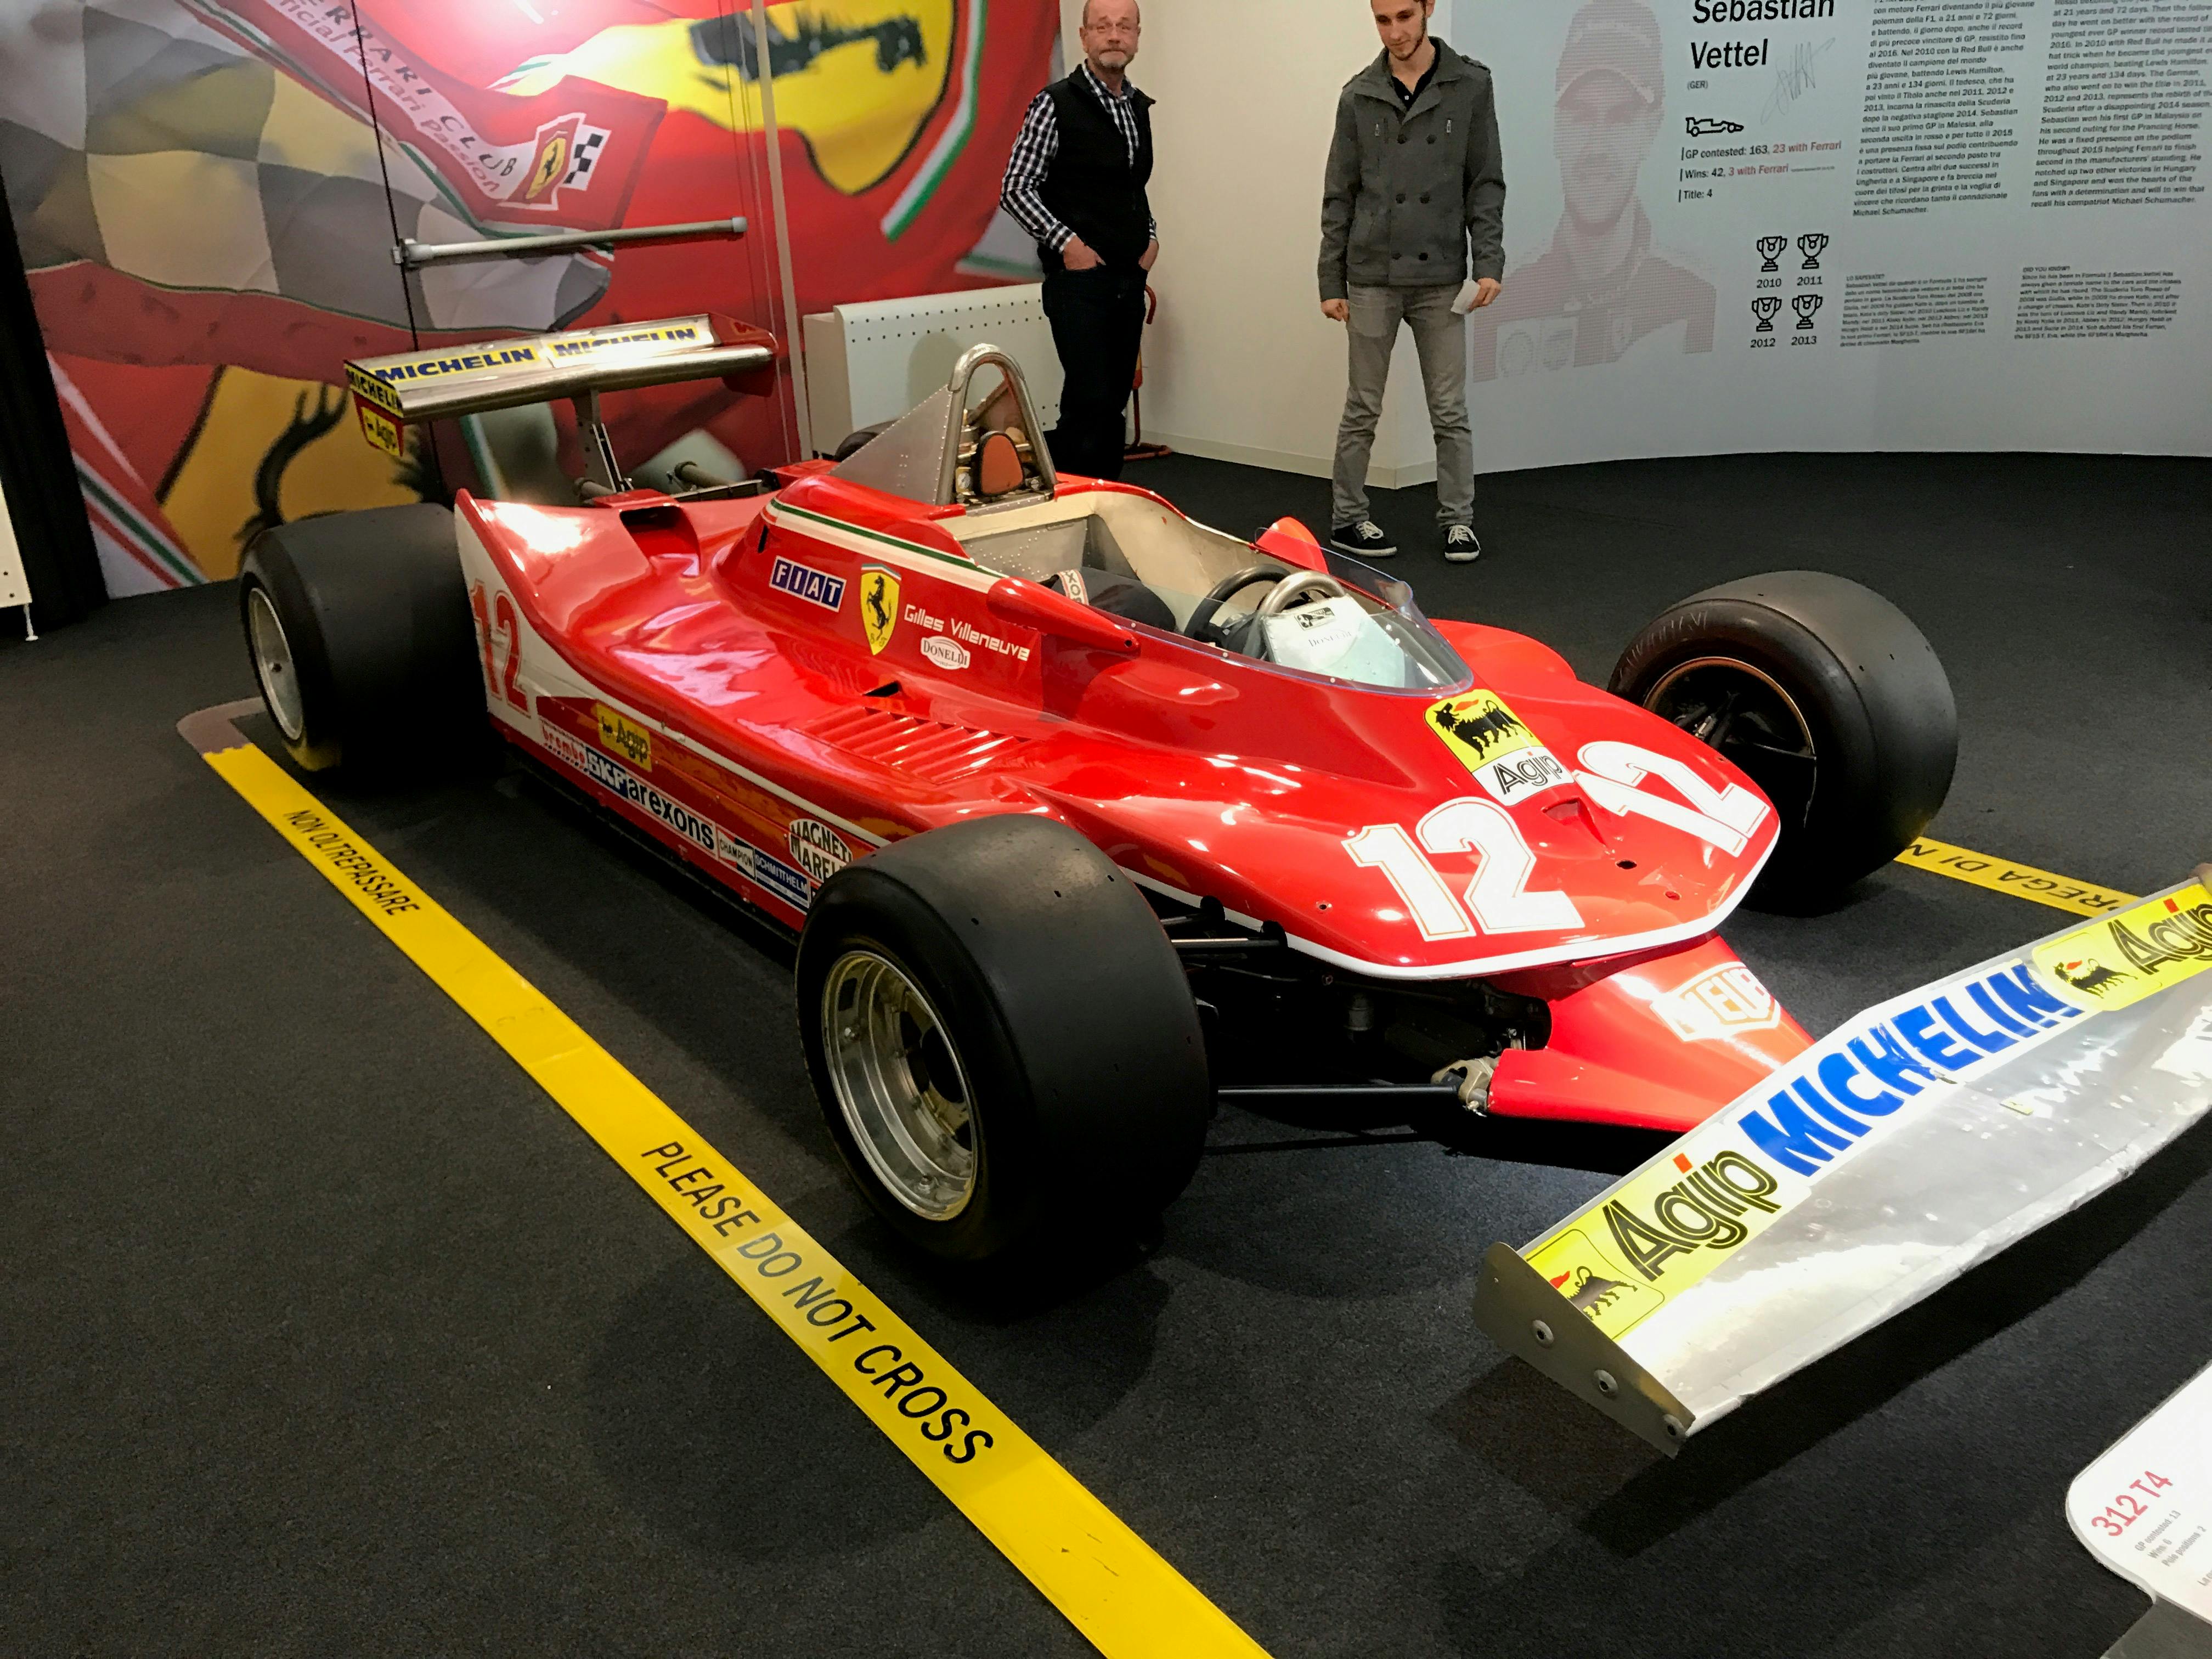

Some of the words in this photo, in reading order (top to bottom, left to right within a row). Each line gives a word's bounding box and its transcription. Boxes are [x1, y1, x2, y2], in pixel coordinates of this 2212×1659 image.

[1692, 0, 1834, 23] Sebastian
[1691, 38, 1768, 69] Vettel
[1687, 81, 1709, 90] (GER)
[439, 115, 518, 177] CLUB
[1685, 150, 1699, 159] GP
[1701, 146, 1747, 158] contested:
[1773, 144, 1786, 154] 23
[1788, 142, 1808, 153] with
[1811, 140, 1842, 151] Ferrari
[1685, 170, 1709, 179] Wins:
[1728, 167, 1735, 176] 3
[1737, 165, 1756, 176] with
[1759, 163, 1788, 174] Ferrari
[1684, 190, 1704, 199] Title:
[1707, 189, 1713, 198] 4
[1757, 278, 1782, 288] 2010
[1797, 276, 1822, 286] 2011
[1751, 338, 1776, 348] 2012
[1791, 335, 1817, 346] 2013
[375, 348, 534, 381] MICHELIN
[772, 562, 842, 606] FIAT
[470, 579, 531, 719] 12
[904, 604, 944, 632] Gilles
[951, 618, 1030, 661] Villeneuve
[1493, 751, 1563, 795] Agip
[629, 778, 714, 850] arexons
[1571, 741, 1770, 858] 12
[719, 838, 753, 867] CHAMPION
[791, 834, 845, 881] MAREL
[1341, 796, 1585, 942] 12
[1938, 856, 1992, 871] DI
[309, 832, 421, 916] OLTREPASSARE
[1997, 871, 2120, 911] REGA
[1602, 1149, 1781, 1282] Agip
[1738, 964, 2085, 1177] MICHELIN
[641, 1142, 760, 1238] PLEASE
[737, 1232, 803, 1278] DO
[782, 1277, 876, 1343] NOT
[854, 1344, 994, 1464] CROSS
